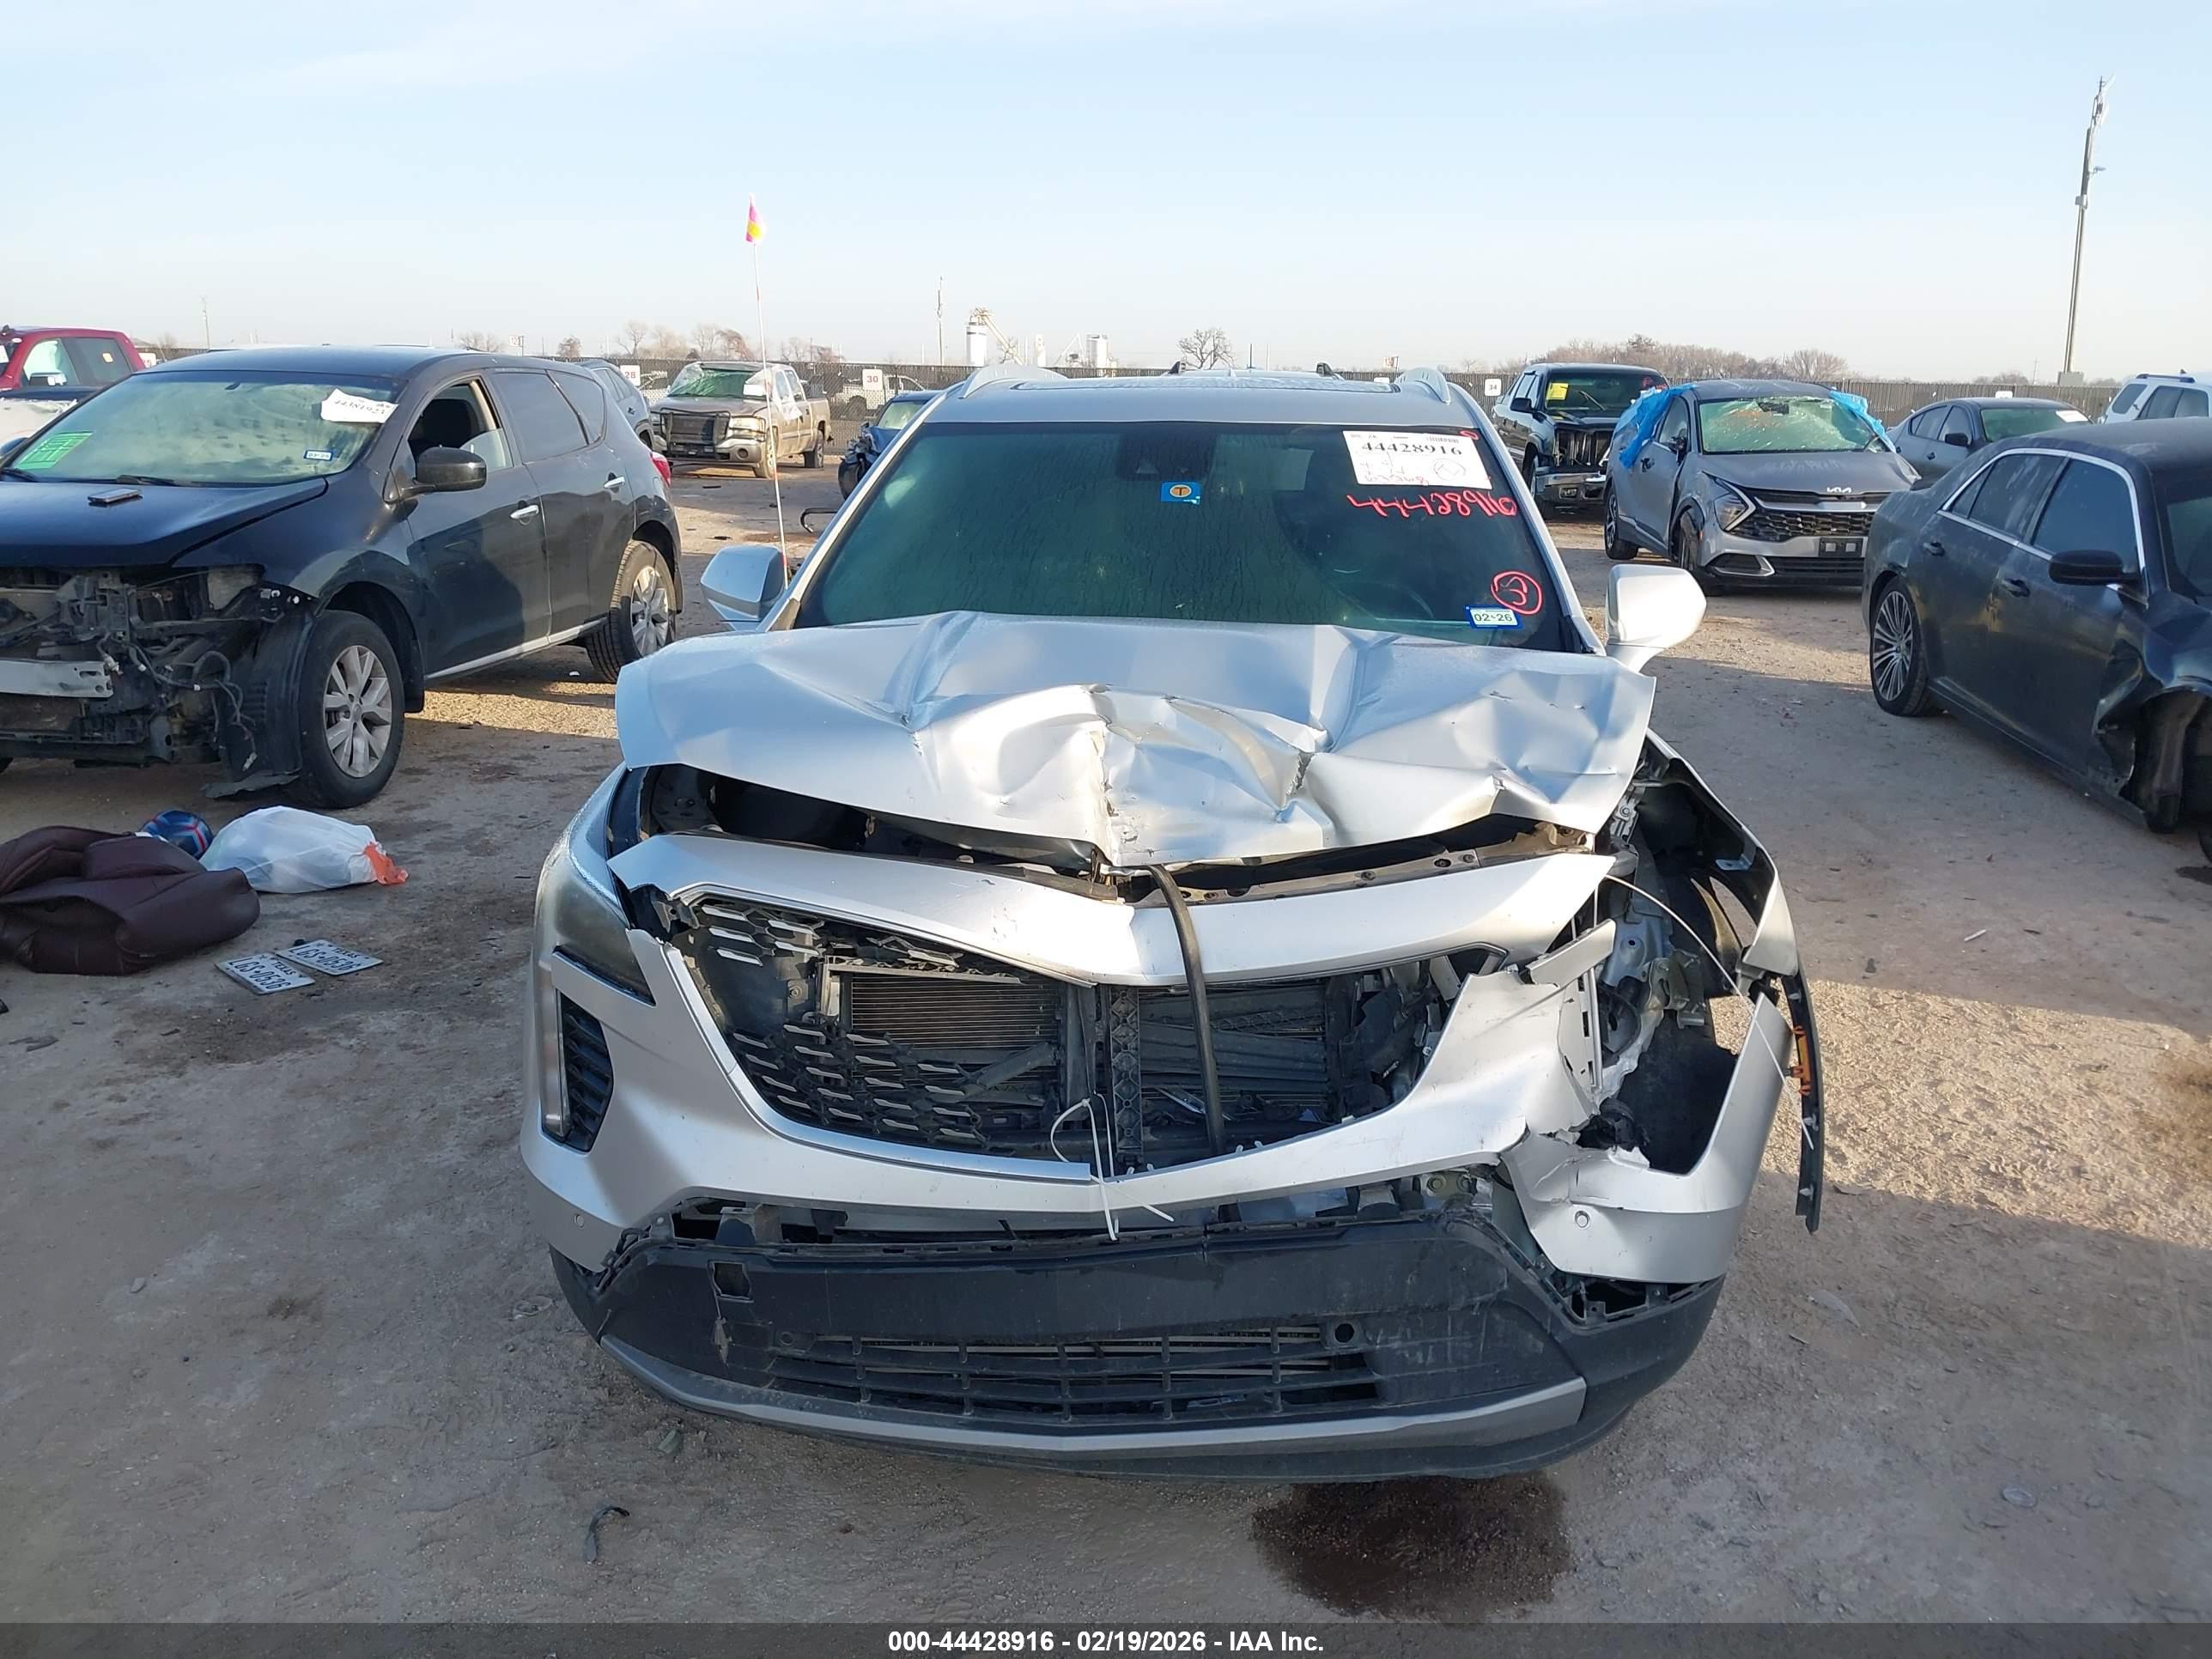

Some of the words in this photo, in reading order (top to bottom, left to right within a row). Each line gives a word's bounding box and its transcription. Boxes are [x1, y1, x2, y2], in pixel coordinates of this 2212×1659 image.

[1362, 441, 1462, 456] 44428916
[331, 947, 361, 958] TEXAS
[273, 961, 296, 975] TEXAS
